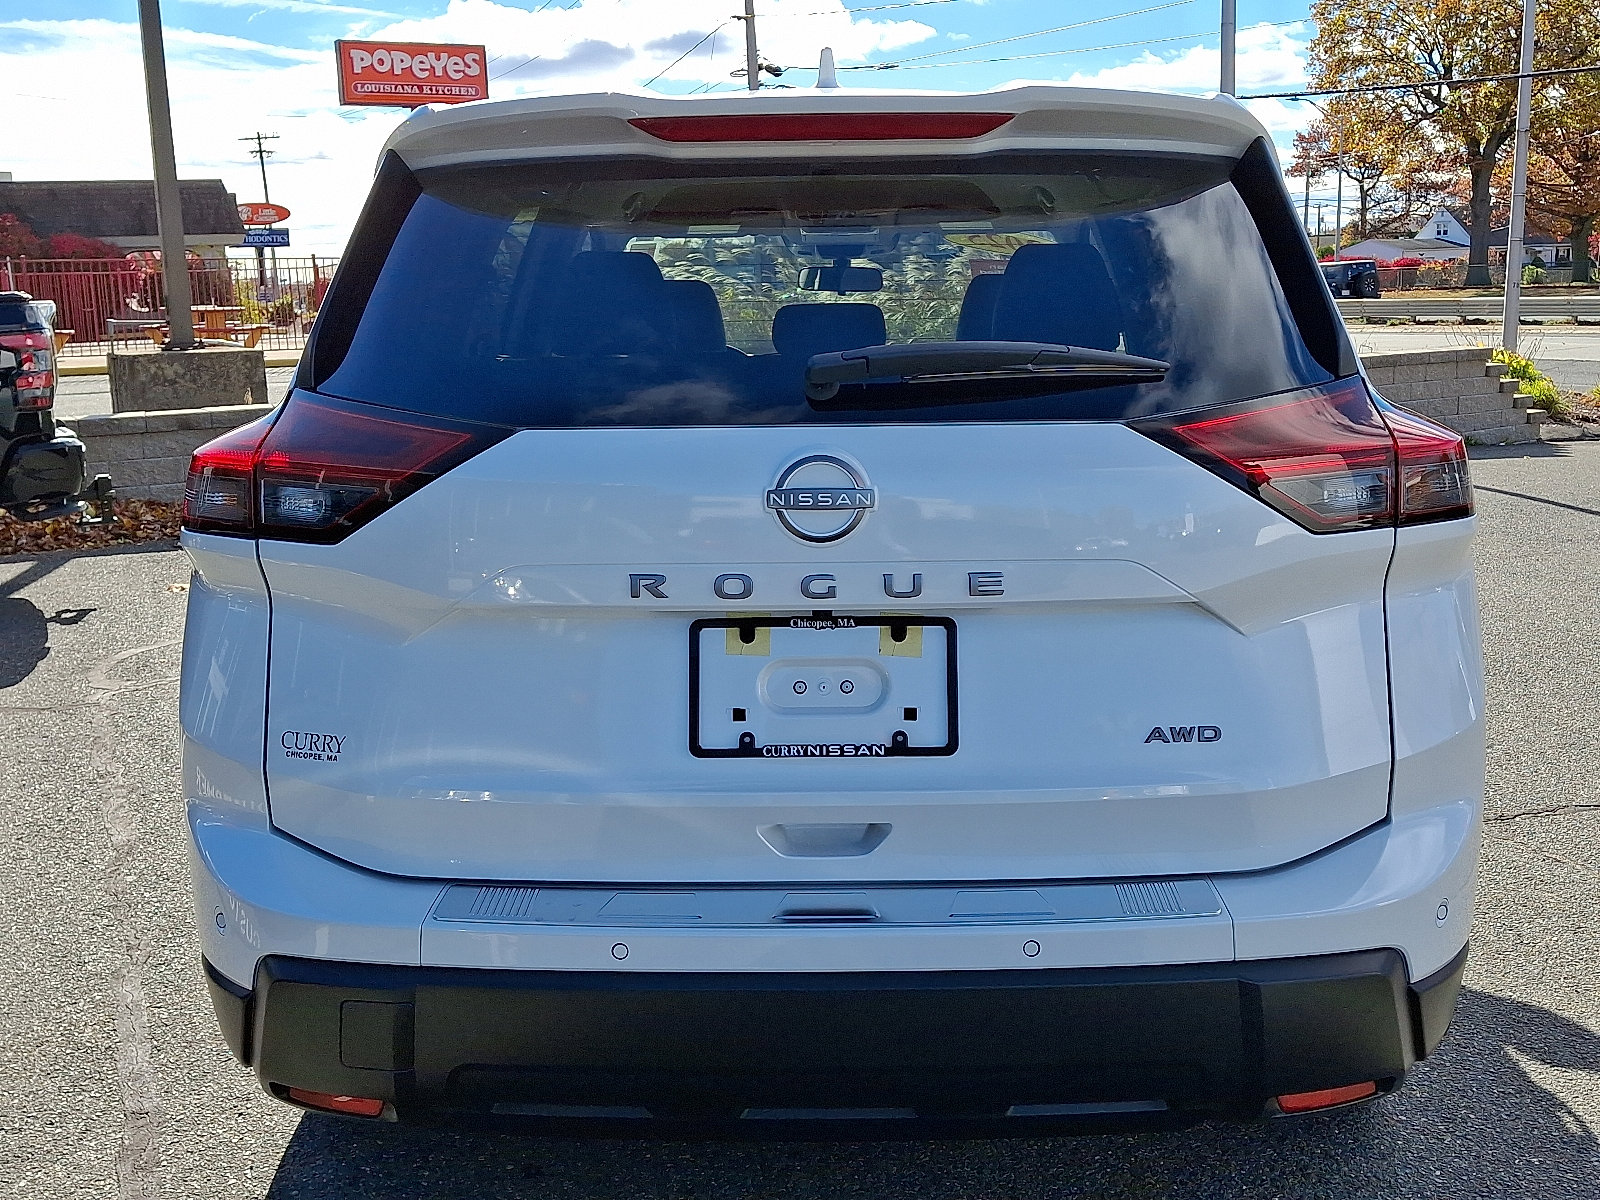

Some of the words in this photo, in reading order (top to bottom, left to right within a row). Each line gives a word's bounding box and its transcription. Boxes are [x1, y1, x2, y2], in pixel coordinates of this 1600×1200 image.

[357, 83, 420, 94] LOUISIANA
[422, 85, 476, 96] KITCHEN
[245, 234, 289, 243] HODONTICS
[769, 493, 871, 506] NISSAN
[628, 571, 1005, 599] ROGUE
[790, 618, 835, 629] Chicopee,
[837, 618, 856, 627] MA
[1143, 725, 1222, 743] AWD
[281, 730, 347, 754] CURRY
[285, 750, 325, 762] CHICOPEE,
[326, 754, 338, 762] MA
